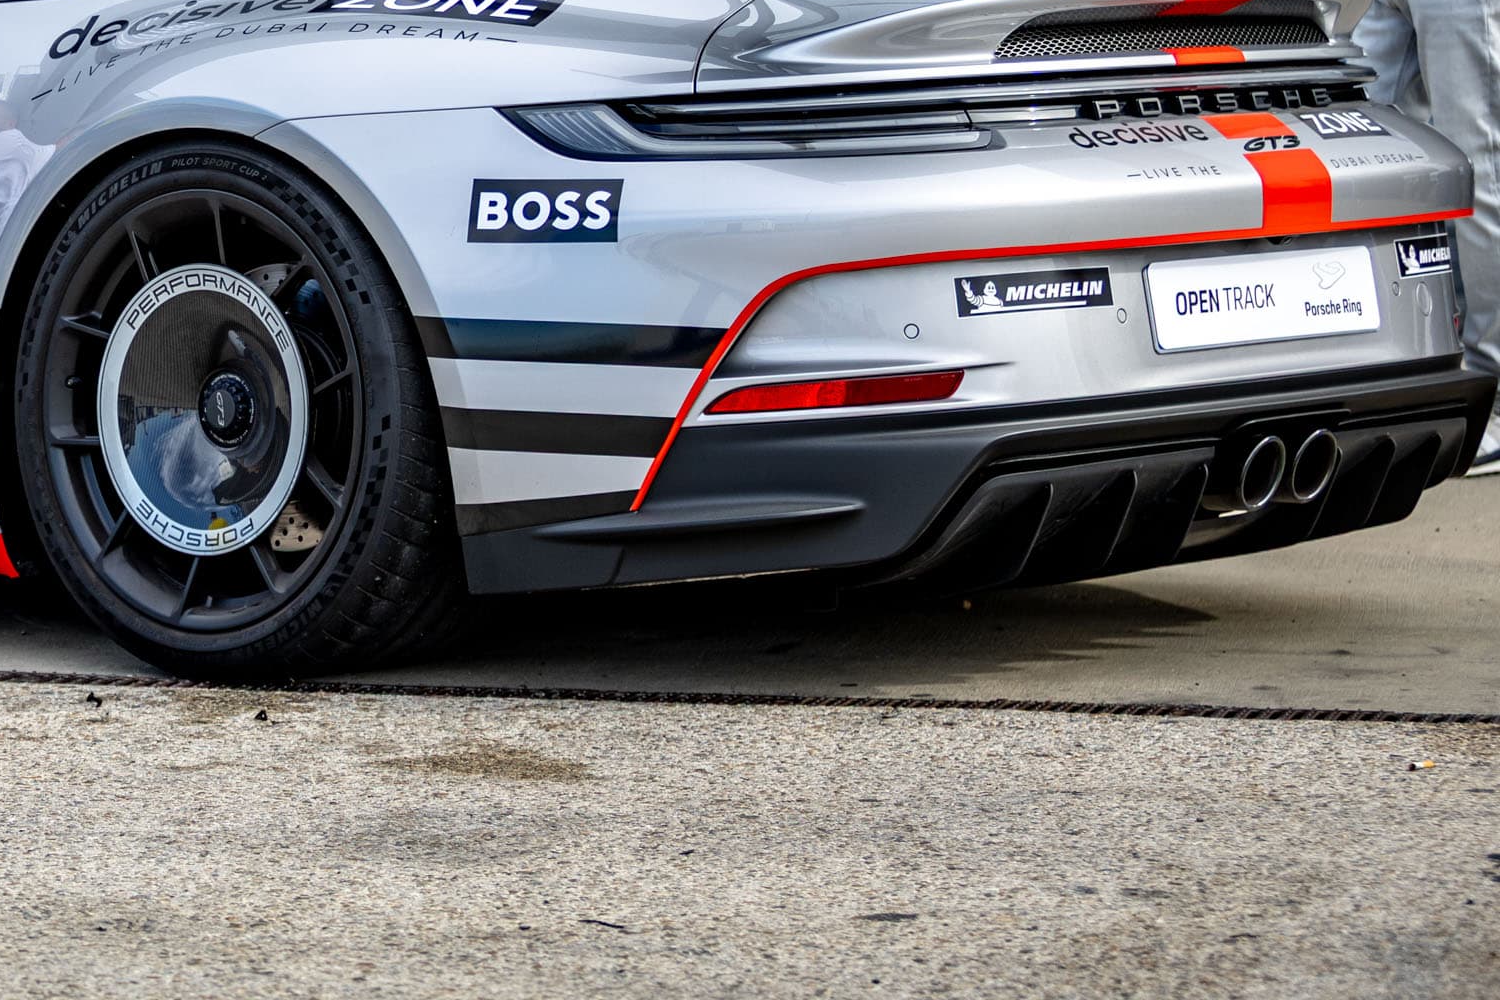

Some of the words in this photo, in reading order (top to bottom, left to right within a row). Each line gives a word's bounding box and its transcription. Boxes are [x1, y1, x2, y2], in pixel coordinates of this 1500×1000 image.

[139, 31, 198, 56] THE
[214, 21, 329, 39] DUBAI
[1094, 88, 1332, 119] PORSCHE
[1068, 121, 1209, 149] decisive
[1300, 111, 1382, 135] ZONE
[1243, 135, 1301, 152] GT3
[1188, 165, 1222, 177] THE
[1330, 155, 1373, 169] DUBAI
[76, 160, 164, 231] MICHELIN
[171, 157, 200, 168] PILOT
[202, 156, 238, 173] SPORT
[238, 164, 261, 179] CUP
[476, 190, 612, 231] BOSS
[1005, 280, 1103, 302] MICHELIN
[1175, 288, 1220, 316] OPEN
[1222, 283, 1276, 311] TRACK
[1304, 298, 1342, 317] Porsche
[1342, 297, 1363, 317] Ring
[126, 273, 290, 353] PERFORMANCE
[135, 498, 255, 547] PORSCHE
